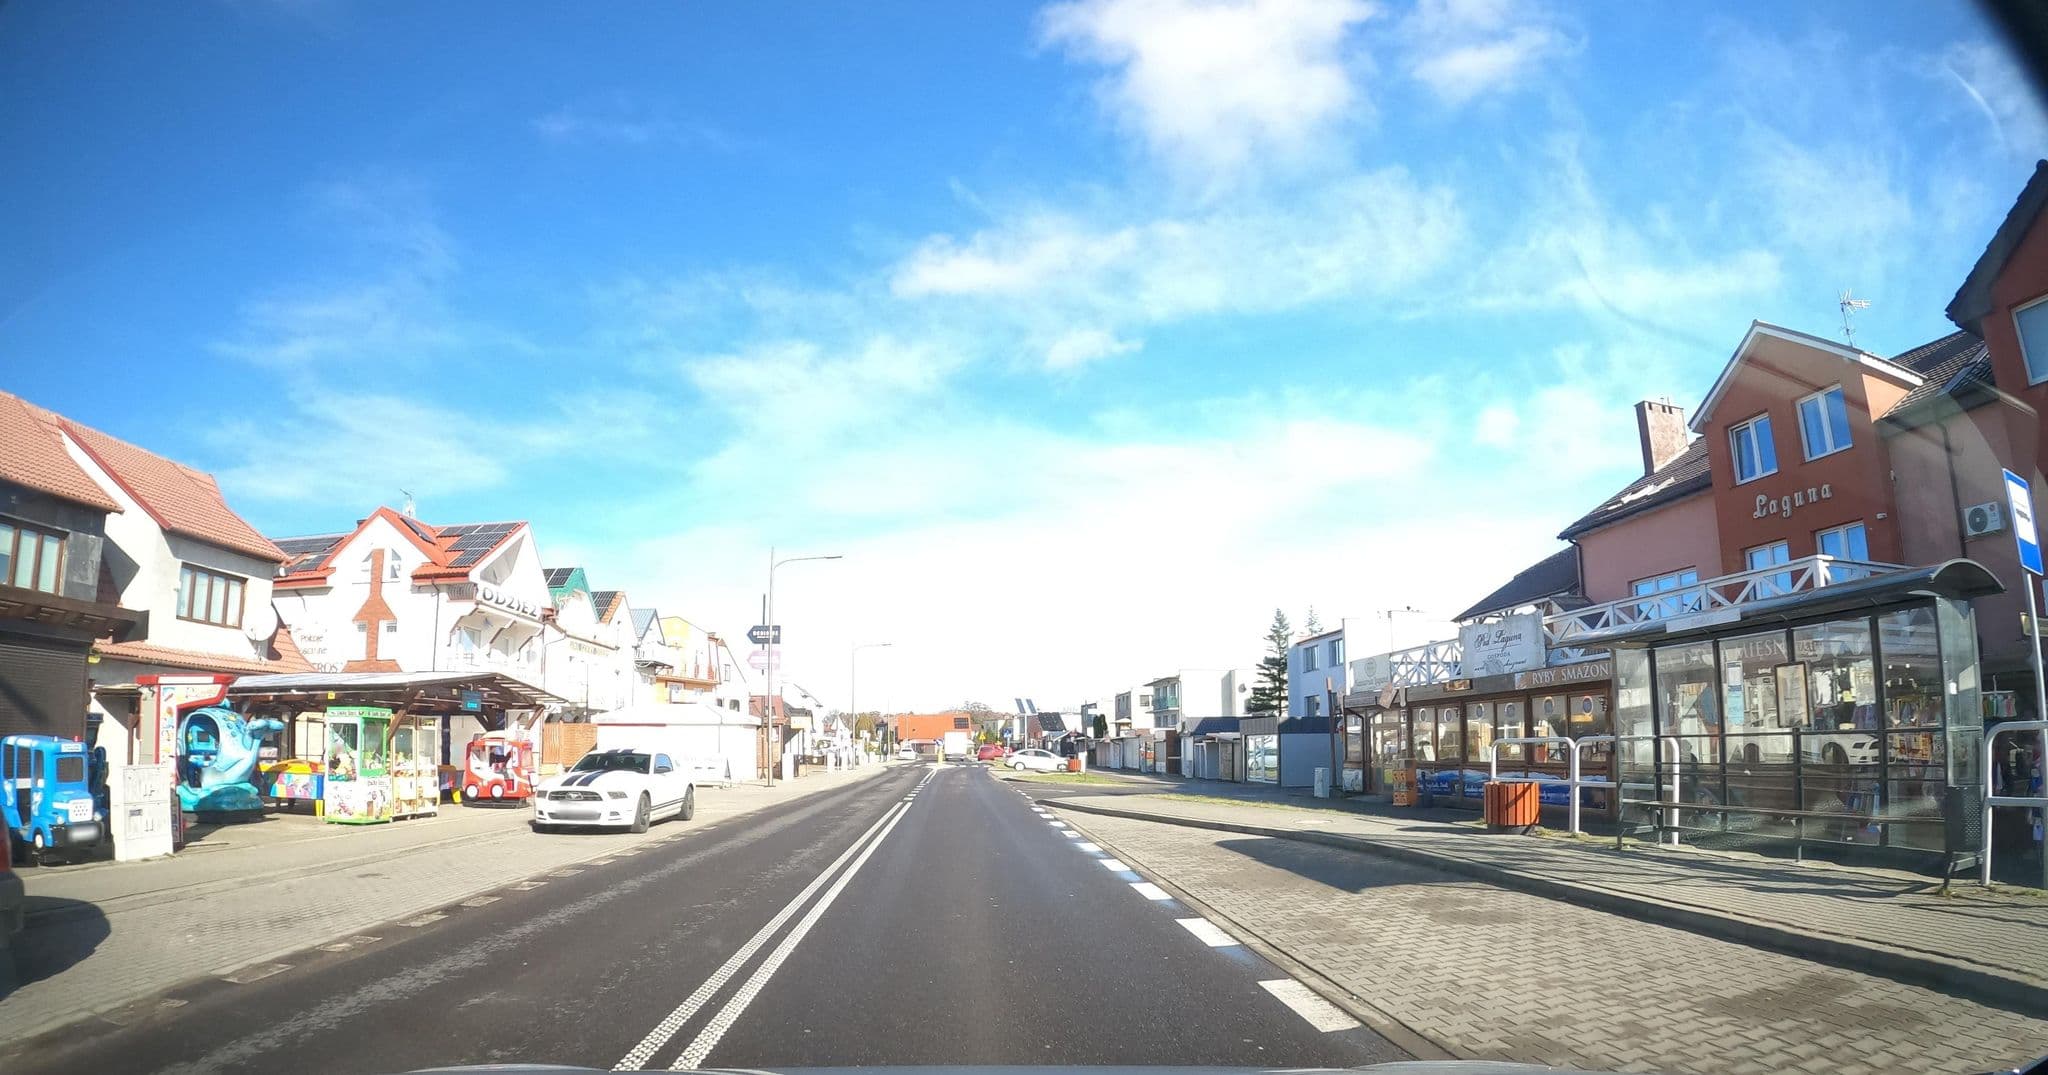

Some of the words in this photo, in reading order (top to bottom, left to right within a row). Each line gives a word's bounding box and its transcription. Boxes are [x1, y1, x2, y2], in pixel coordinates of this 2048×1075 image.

[1753, 484, 1831, 518] Laguna
[1532, 670, 1556, 685] RYBY
[1561, 662, 1610, 681] SMAŻON
